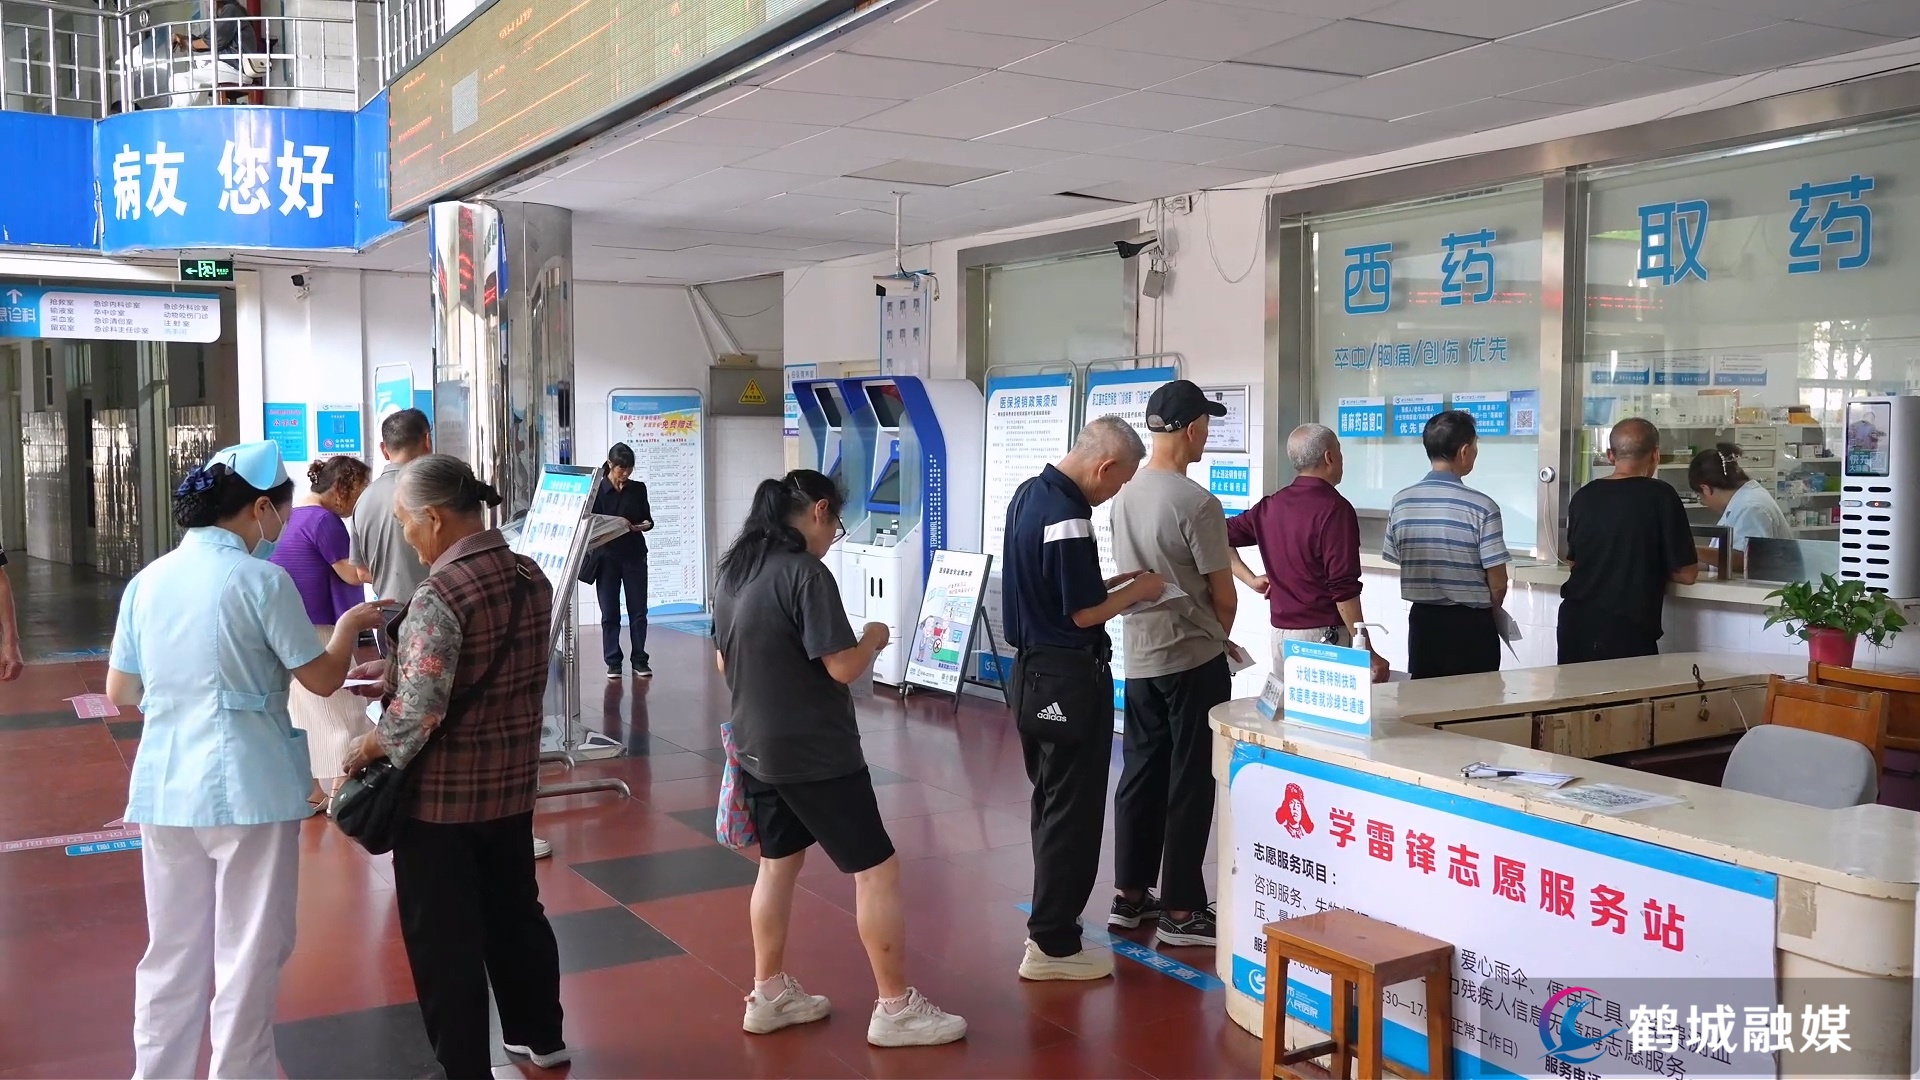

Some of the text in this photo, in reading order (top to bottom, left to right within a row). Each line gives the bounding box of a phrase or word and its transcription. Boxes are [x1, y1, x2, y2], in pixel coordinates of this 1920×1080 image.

[113, 141, 188, 220] 病友
[217, 139, 334, 219] 您好
[1344, 174, 1875, 316] 西药 取药
[0, 307, 36, 323] 急诊科
[94, 300, 141, 309] 急诊内科诊室
[163, 303, 209, 312] 急诊外科诊室
[94, 309, 125, 317] 卒中诊室
[50, 316, 75, 324] 采血室
[163, 320, 190, 328] 注射室
[94, 325, 149, 335] 急诊科主任诊室
[1334, 337, 1508, 369] 卒中/胸痛/创伤 优先
[1000, 392, 1058, 409] 医保报销政策须知
[1341, 412, 1382, 432] 精麻药品窗口
[1296, 665, 1357, 691] 计划生育特别扶助
[1289, 686, 1364, 715] 家庭患者就诊绿色通道
[1037, 712, 1067, 722] adidas
[1328, 806, 1687, 953] 学雷锋志愿服务站
[1286, 997, 1319, 1018] 人民医院
